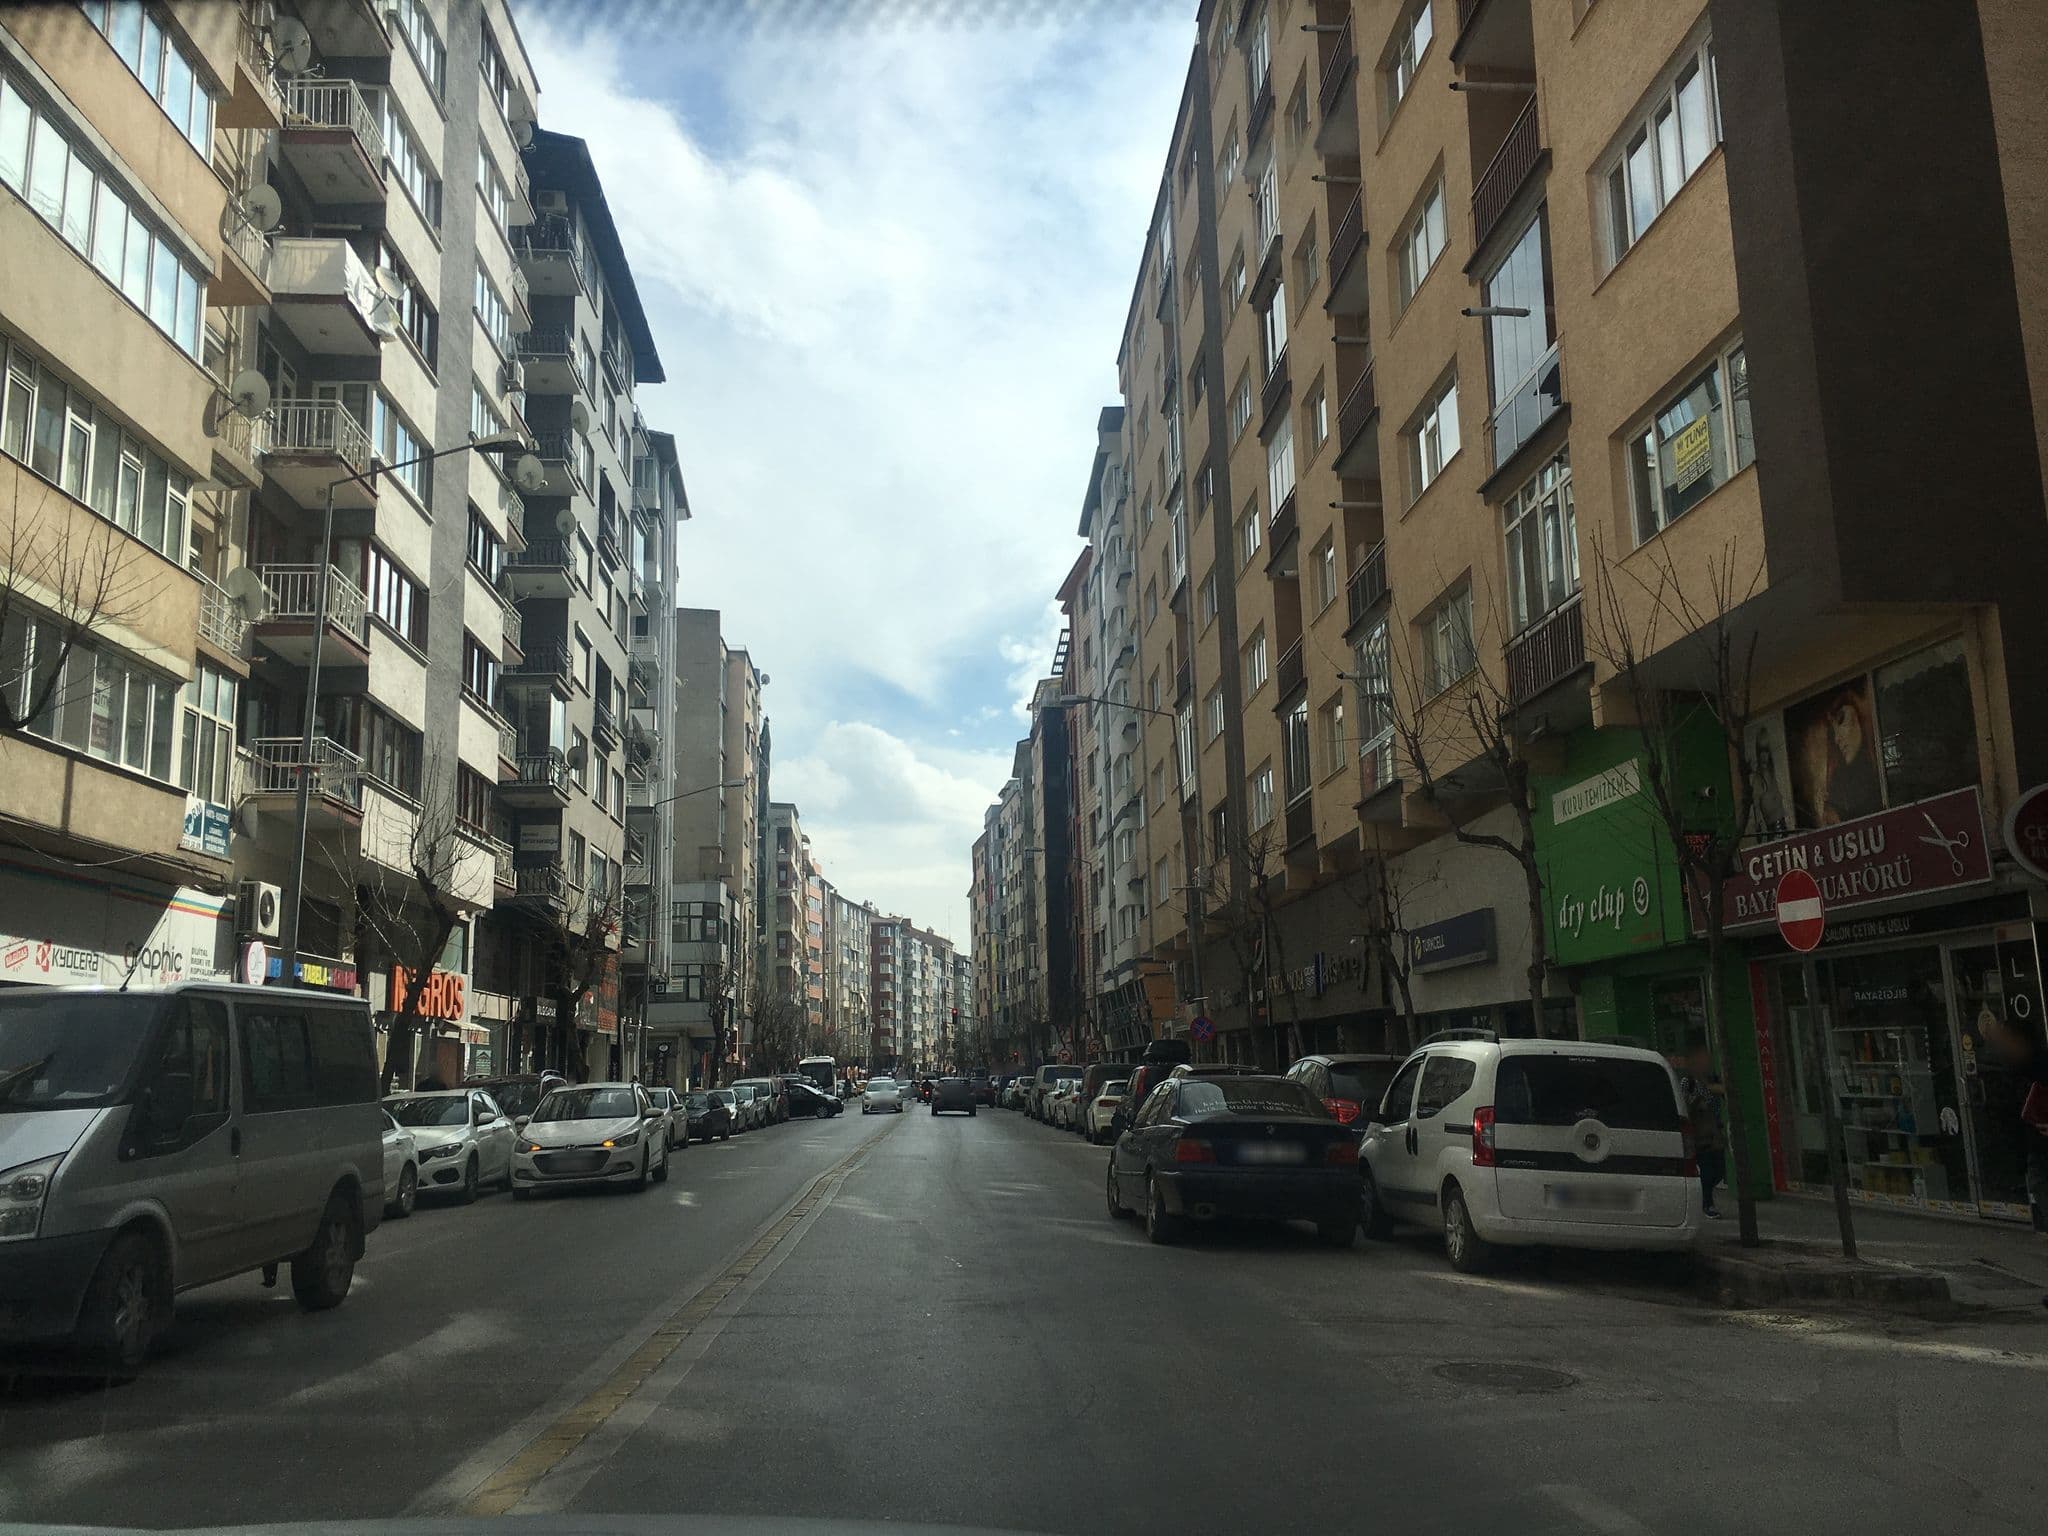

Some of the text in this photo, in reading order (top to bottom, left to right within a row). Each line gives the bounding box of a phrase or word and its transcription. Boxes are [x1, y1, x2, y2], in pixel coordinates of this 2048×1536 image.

[1685, 421, 1707, 448] TUNA
[1562, 772, 1631, 817] KURU TEMİZLEME
[1748, 824, 1885, 885] ÇETİN & USLU
[1560, 894, 1584, 938] dry
[1590, 885, 1624, 930] clup
[1736, 854, 1912, 917] BAYA UAFÖRÜ
[52, 947, 99, 972] KYOCERA
[1757, 1029, 1777, 1122] MATRIX
